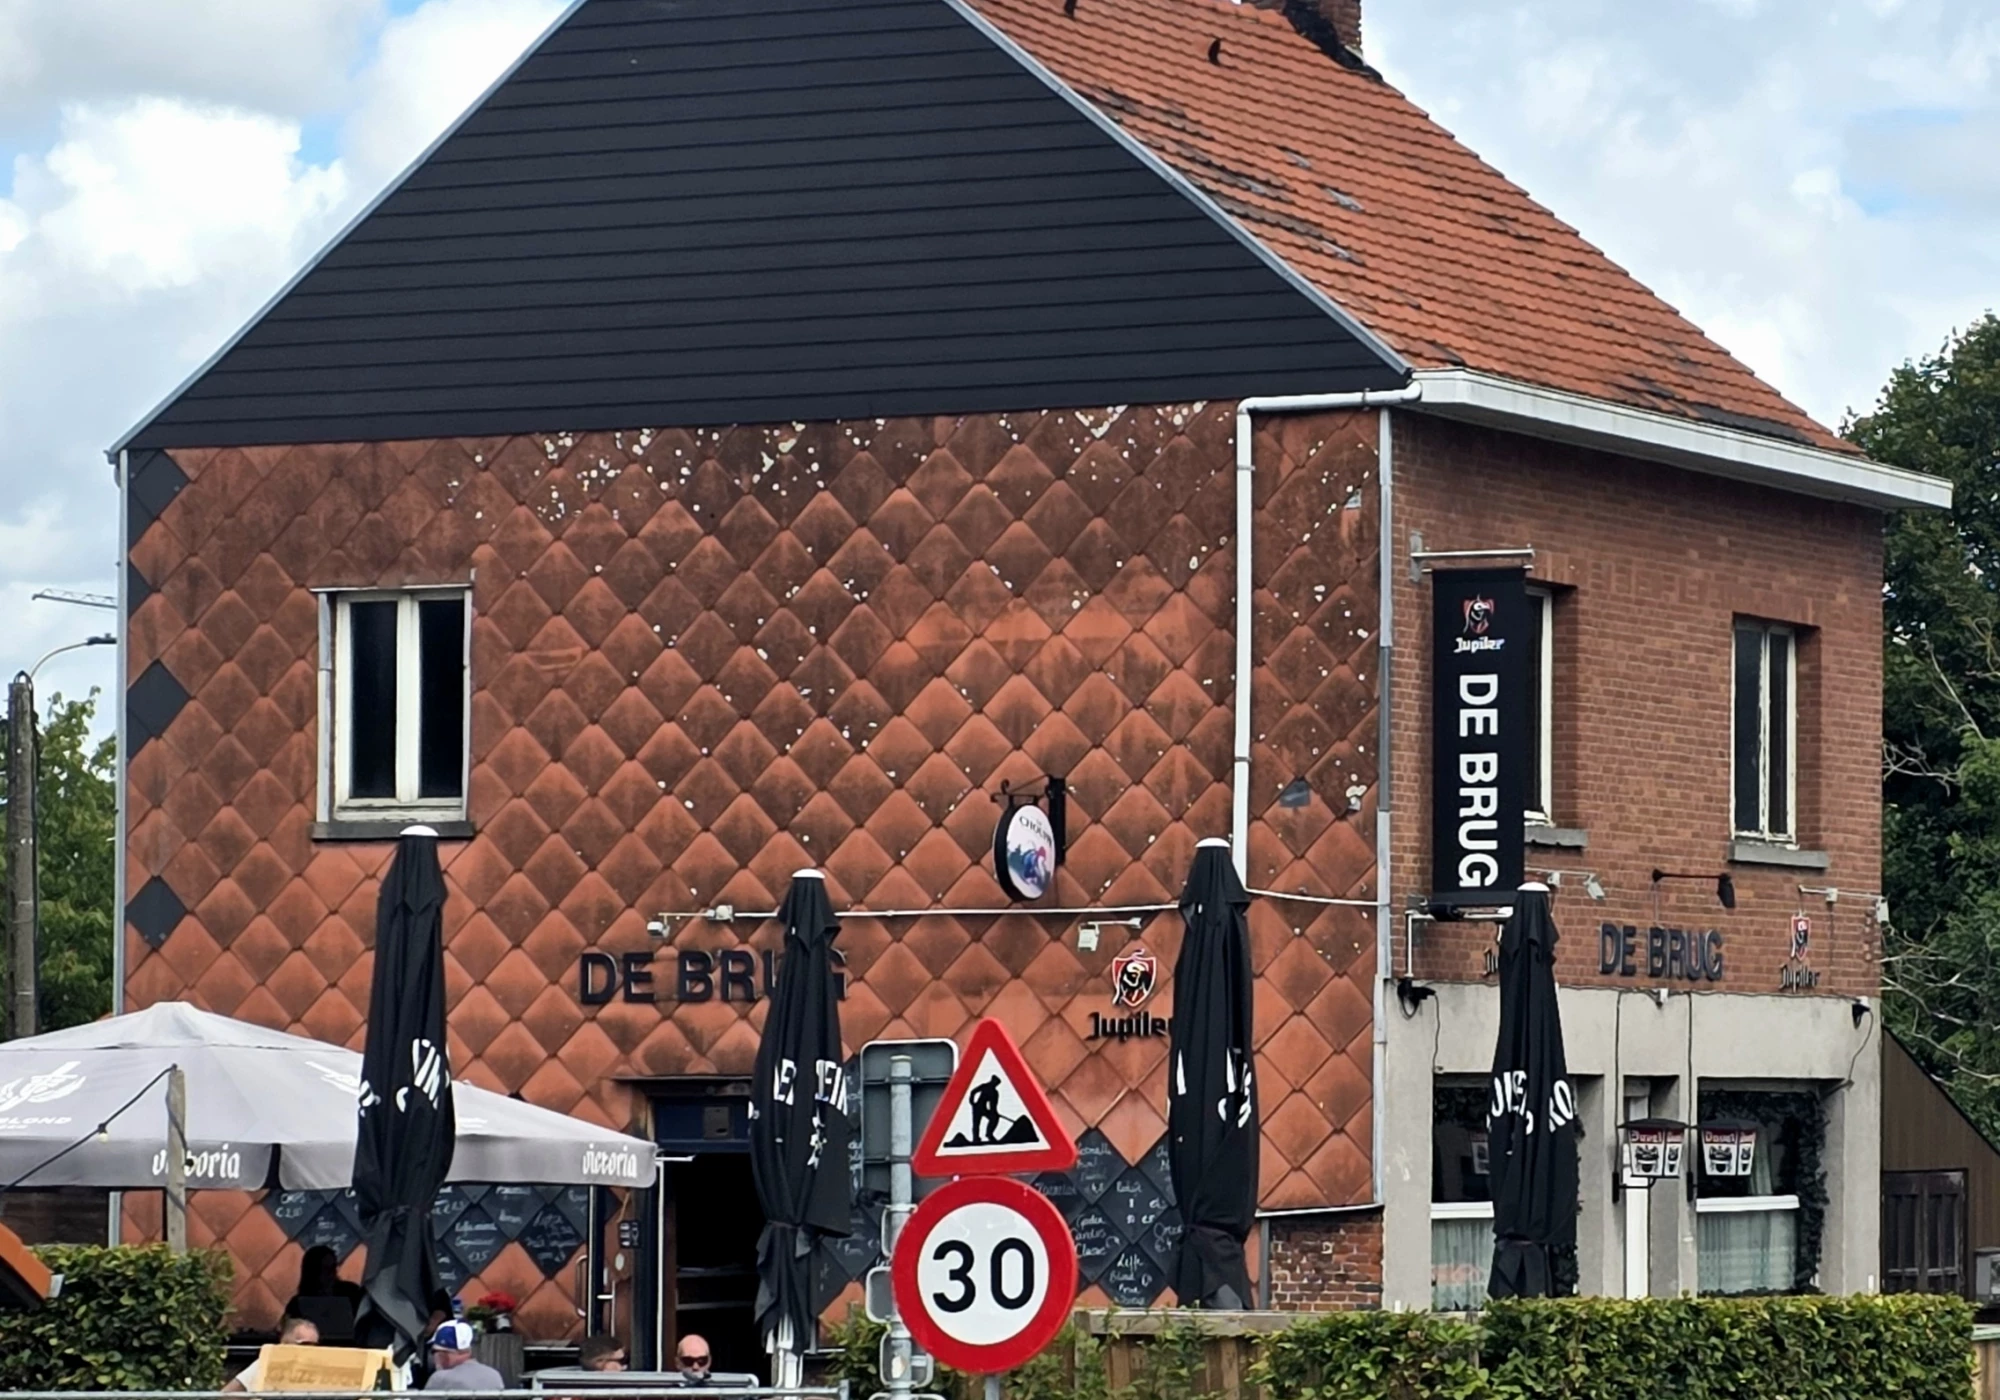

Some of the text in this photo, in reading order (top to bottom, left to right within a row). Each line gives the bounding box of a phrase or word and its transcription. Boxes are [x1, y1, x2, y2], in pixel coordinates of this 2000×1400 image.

[1454, 637, 1505, 653] Jupiler
[1458, 673, 1498, 888] DE BRUG
[579, 951, 656, 1005] DE
[1600, 922, 1723, 982] DE BRUG
[152, 1143, 240, 1179] vtoria
[582, 1142, 638, 1179] victoria
[932, 1237, 1035, 1313] 30
